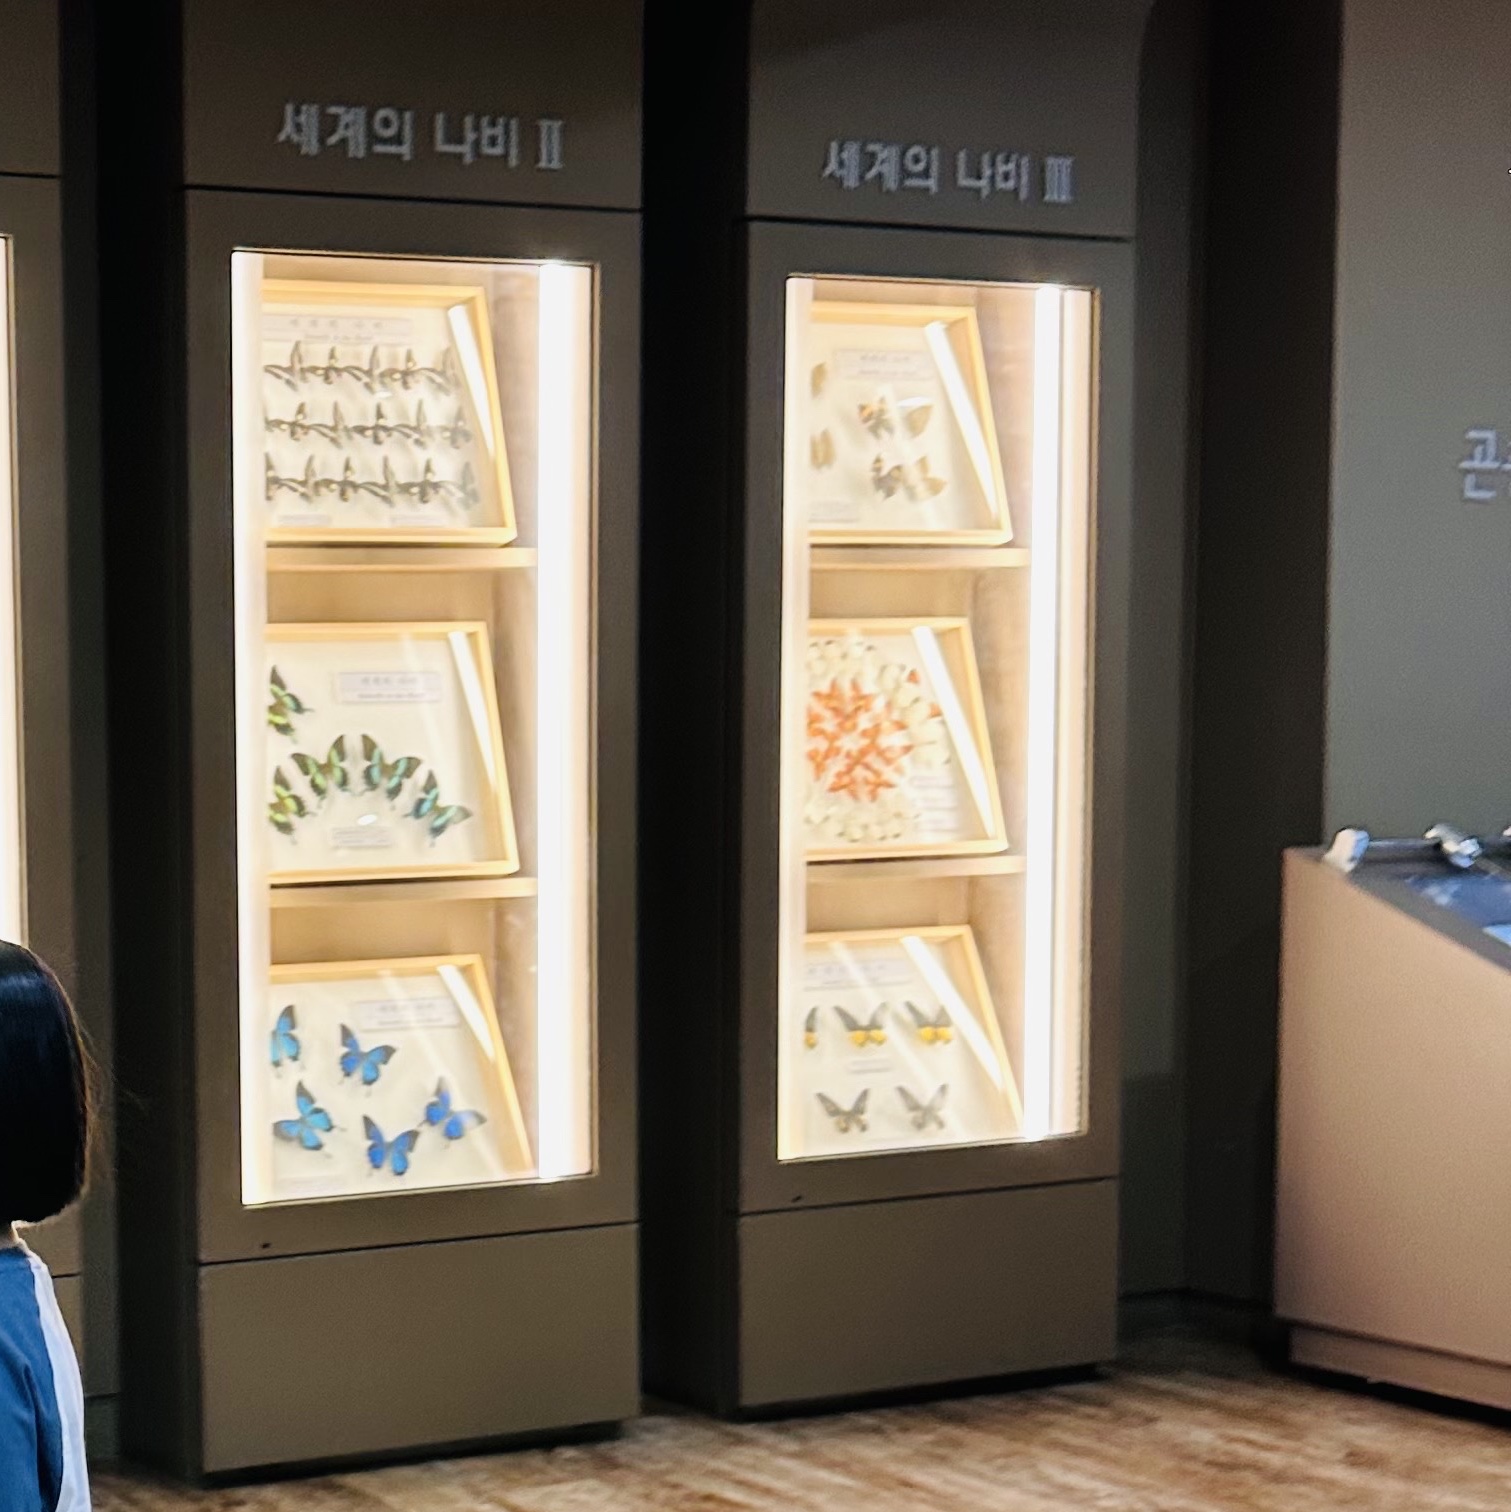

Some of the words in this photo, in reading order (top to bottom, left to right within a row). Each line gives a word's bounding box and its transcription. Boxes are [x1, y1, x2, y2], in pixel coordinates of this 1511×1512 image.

[277, 103, 415, 161] 세계의
[434, 111, 520, 169] 나비
[822, 139, 940, 195] 세계의
[956, 148, 1031, 202] 나비
[1458, 428, 1511, 500] 곤
